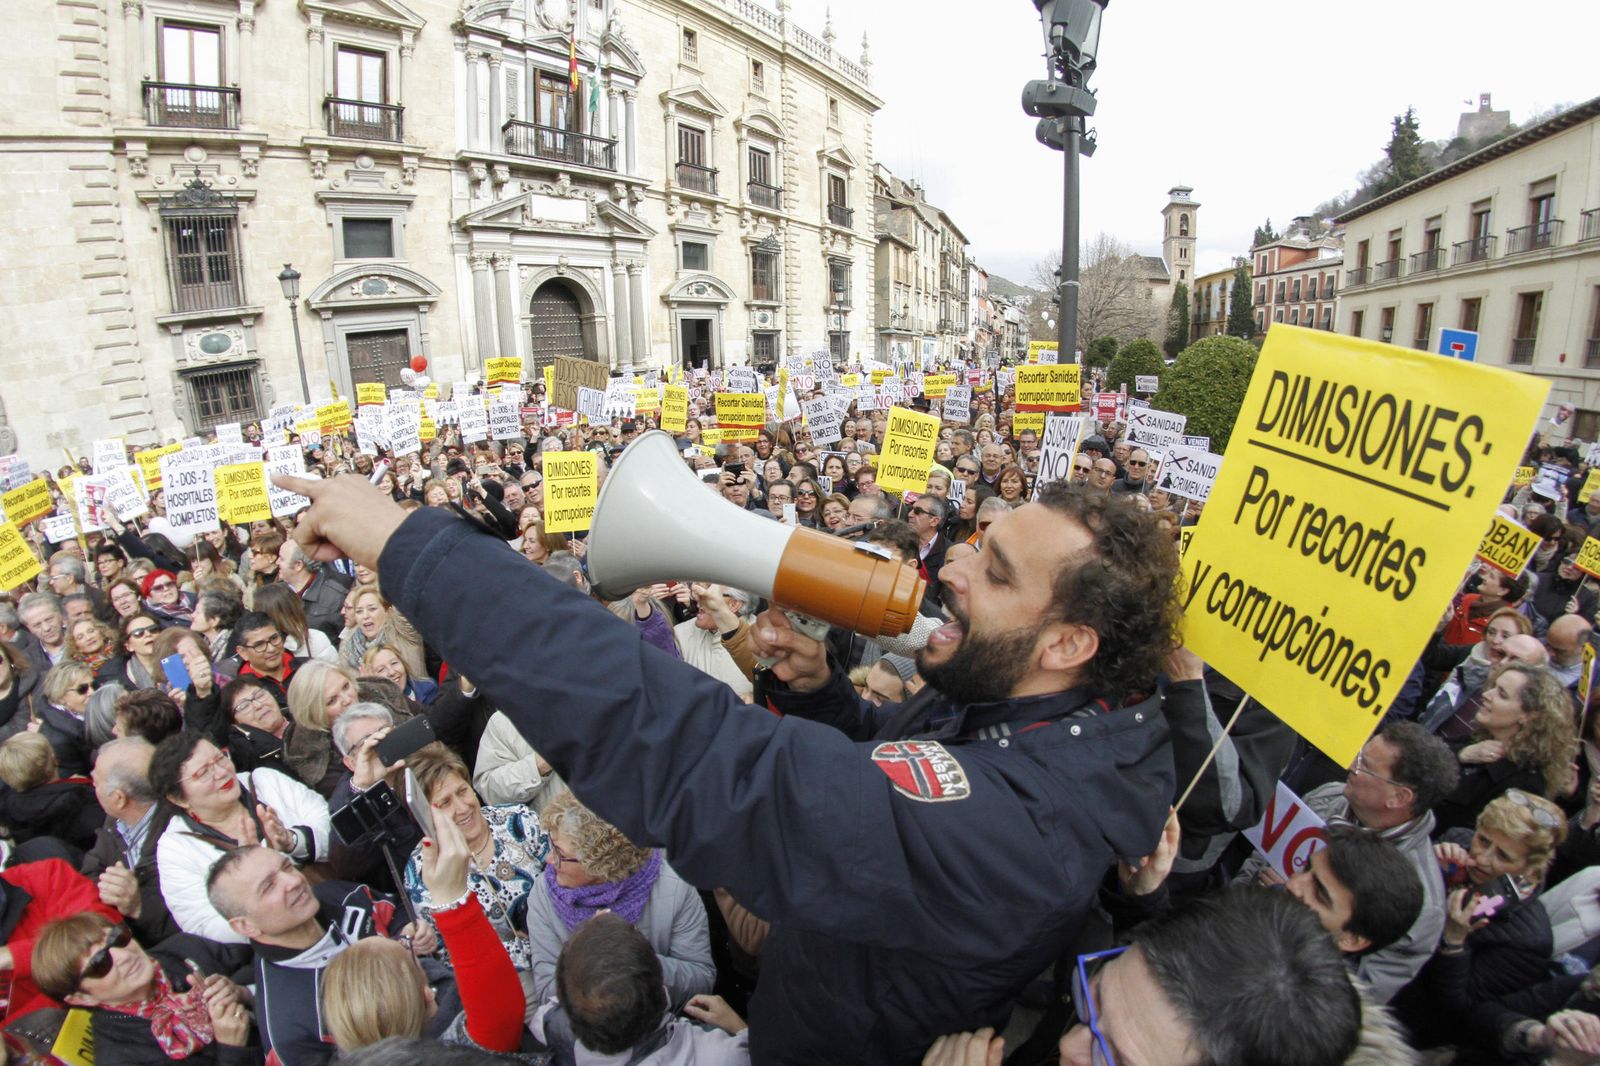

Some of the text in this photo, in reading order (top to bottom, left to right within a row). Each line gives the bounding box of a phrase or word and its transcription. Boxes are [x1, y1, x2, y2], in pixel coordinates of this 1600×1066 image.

[814, 360, 830, 370] NO
[795, 376, 814, 388] NO
[1018, 371, 1048, 384] Recortar
[1050, 370, 1080, 386] Sanidad,
[904, 386, 918, 396] NO
[1019, 388, 1054, 404] corrupción
[718, 398, 740, 408] Recortar
[875, 395, 894, 407] NO
[718, 412, 746, 422] corrupción
[808, 414, 835, 427] HOSPITALES
[812, 425, 839, 440] COMPLETOS
[890, 416, 934, 440] DIMISIONES:
[1046, 418, 1080, 450] SUSANA
[1255, 369, 1493, 498] DIMISIONES:
[302, 432, 320, 446] NO
[1138, 430, 1160, 446] CRIMEN
[889, 440, 902, 454] Por
[902, 443, 928, 460] recortes
[1040, 448, 1070, 480] NO
[1186, 460, 1216, 478] SANID
[886, 464, 928, 483] corrupciones.
[229, 488, 240, 500] Por
[240, 486, 263, 498] recortes
[552, 484, 590, 500] Por recortes
[1172, 476, 1200, 496] CRIMEN
[4, 491, 25, 508] Recortar
[167, 488, 214, 508] HOSPITALES
[272, 494, 308, 510] COMPLETOS
[170, 508, 216, 527] COMPLETOS
[1234, 464, 1426, 602] Por recortes
[1478, 540, 1524, 572] SALUD!
[1183, 560, 1392, 716] y corrupciones.
[916, 744, 956, 796] HANSEN
[932, 744, 966, 788] HELLY
